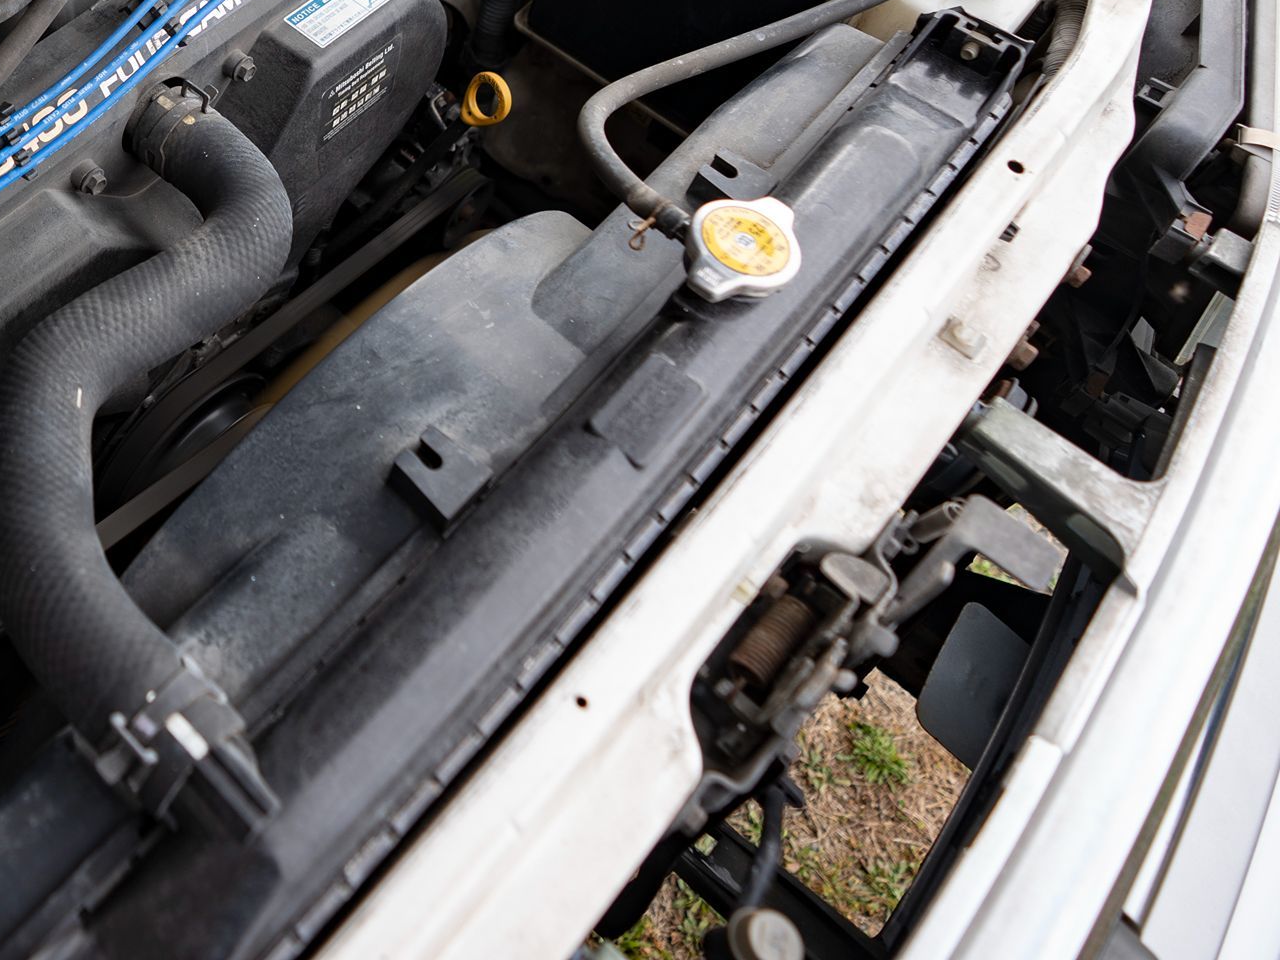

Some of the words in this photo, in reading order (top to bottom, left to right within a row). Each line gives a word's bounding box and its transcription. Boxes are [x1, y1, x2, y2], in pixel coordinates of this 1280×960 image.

[291, 1, 321, 24] NOTICE
[335, 65, 365, 93] Mitsuboshi
[365, 51, 384, 70] Belting
[384, 43, 395, 55] Ltd.
[13, 107, 29, 121] PLUG
